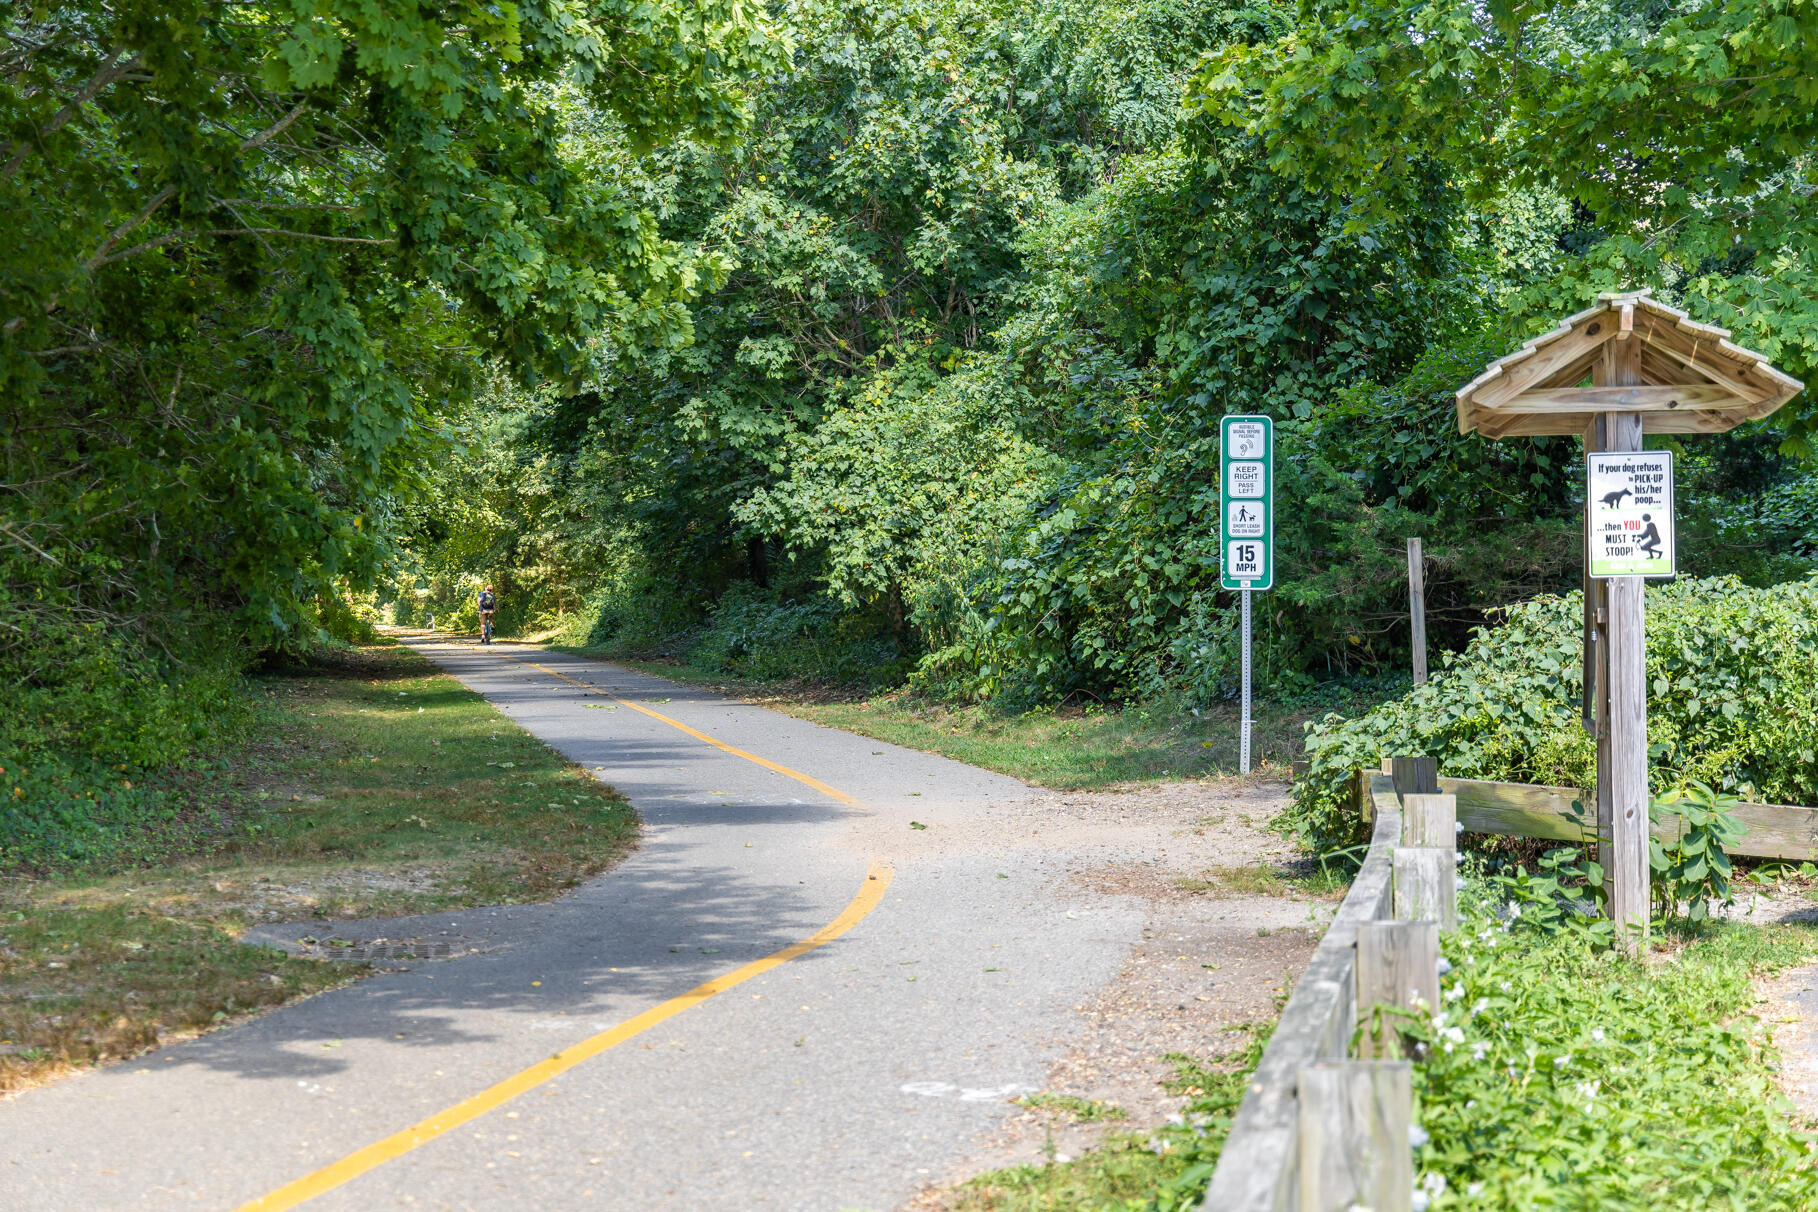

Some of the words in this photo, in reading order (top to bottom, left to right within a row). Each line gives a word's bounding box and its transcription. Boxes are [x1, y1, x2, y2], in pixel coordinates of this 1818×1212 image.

[1598, 463, 1605, 473] If
[1605, 465, 1621, 474] your
[1622, 463, 1635, 474] dog
[1636, 462, 1662, 472] refuses
[1634, 474, 1664, 483] PICK-UP
[1635, 484, 1662, 494] his/her
[1635, 496, 1662, 505] poop...
[1597, 523, 1622, 532] ...then
[1623, 520, 1641, 531] YOU
[1605, 534, 1627, 544] MUST
[1236, 544, 1255, 562] 15
[1605, 546, 1634, 557] STOOP!
[1236, 563, 1256, 572] MPH
